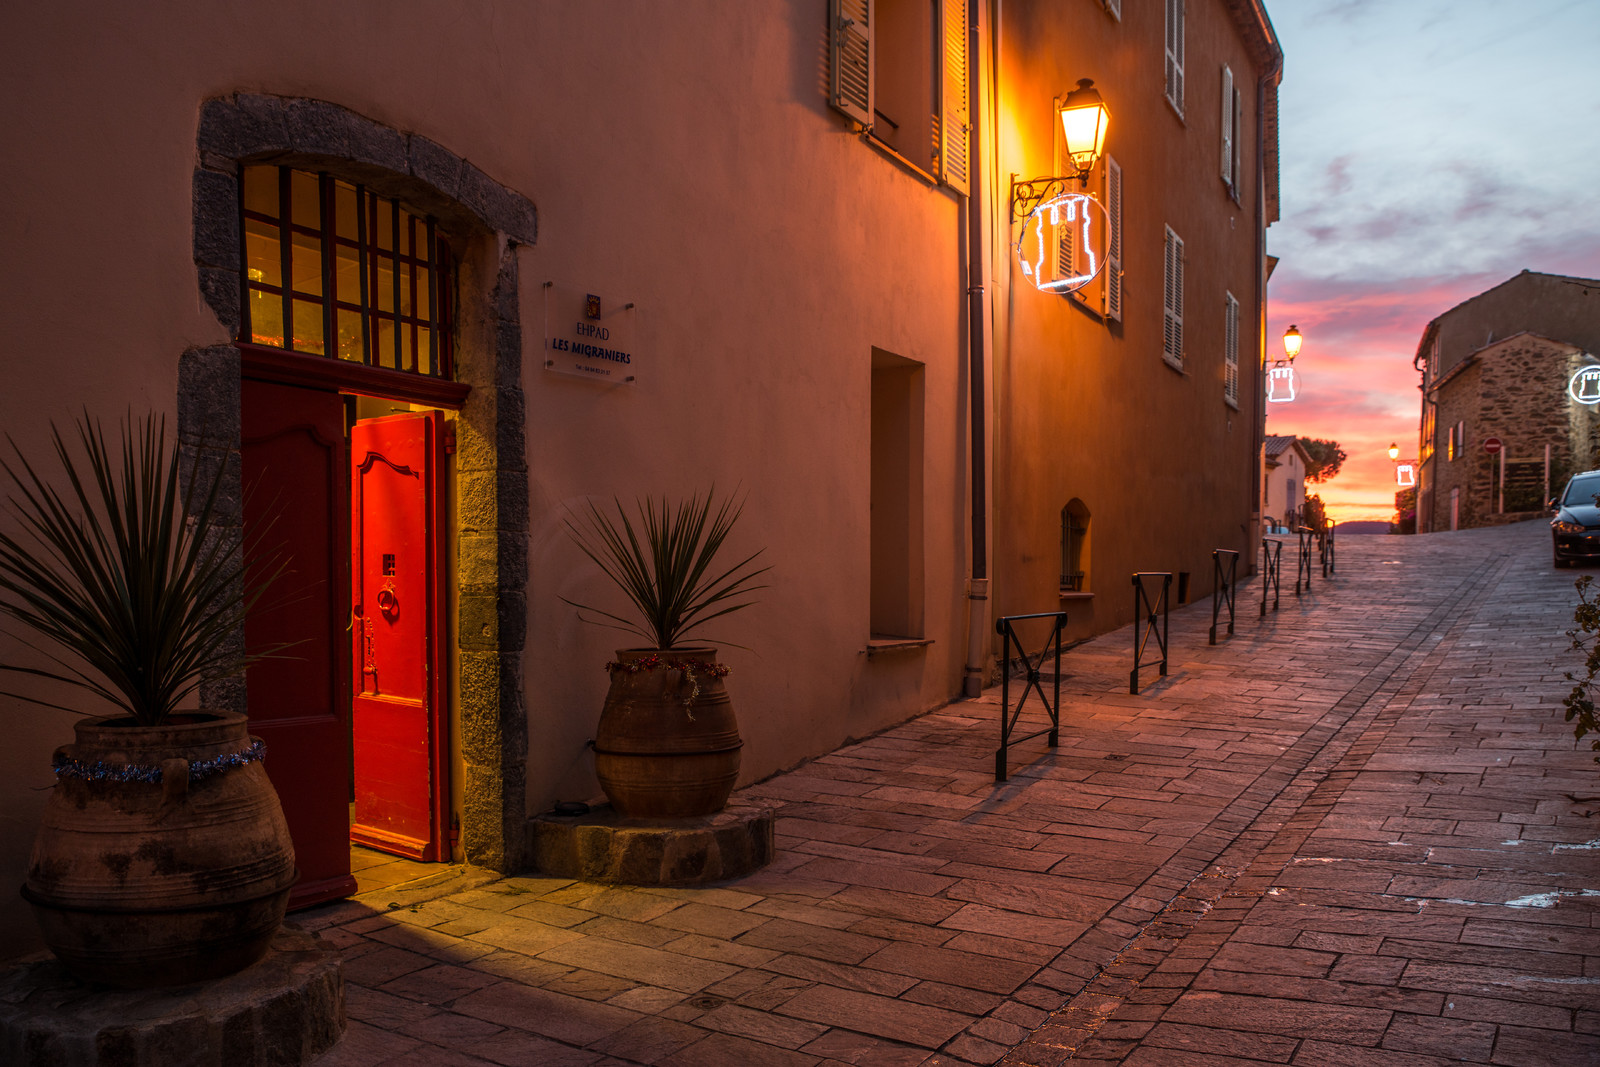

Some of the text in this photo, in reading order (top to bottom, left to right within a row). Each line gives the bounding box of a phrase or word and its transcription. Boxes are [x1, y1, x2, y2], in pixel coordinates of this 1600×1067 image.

[577, 322, 609, 340] EHPAD
[552, 338, 631, 364] LES MIGRANIERS
